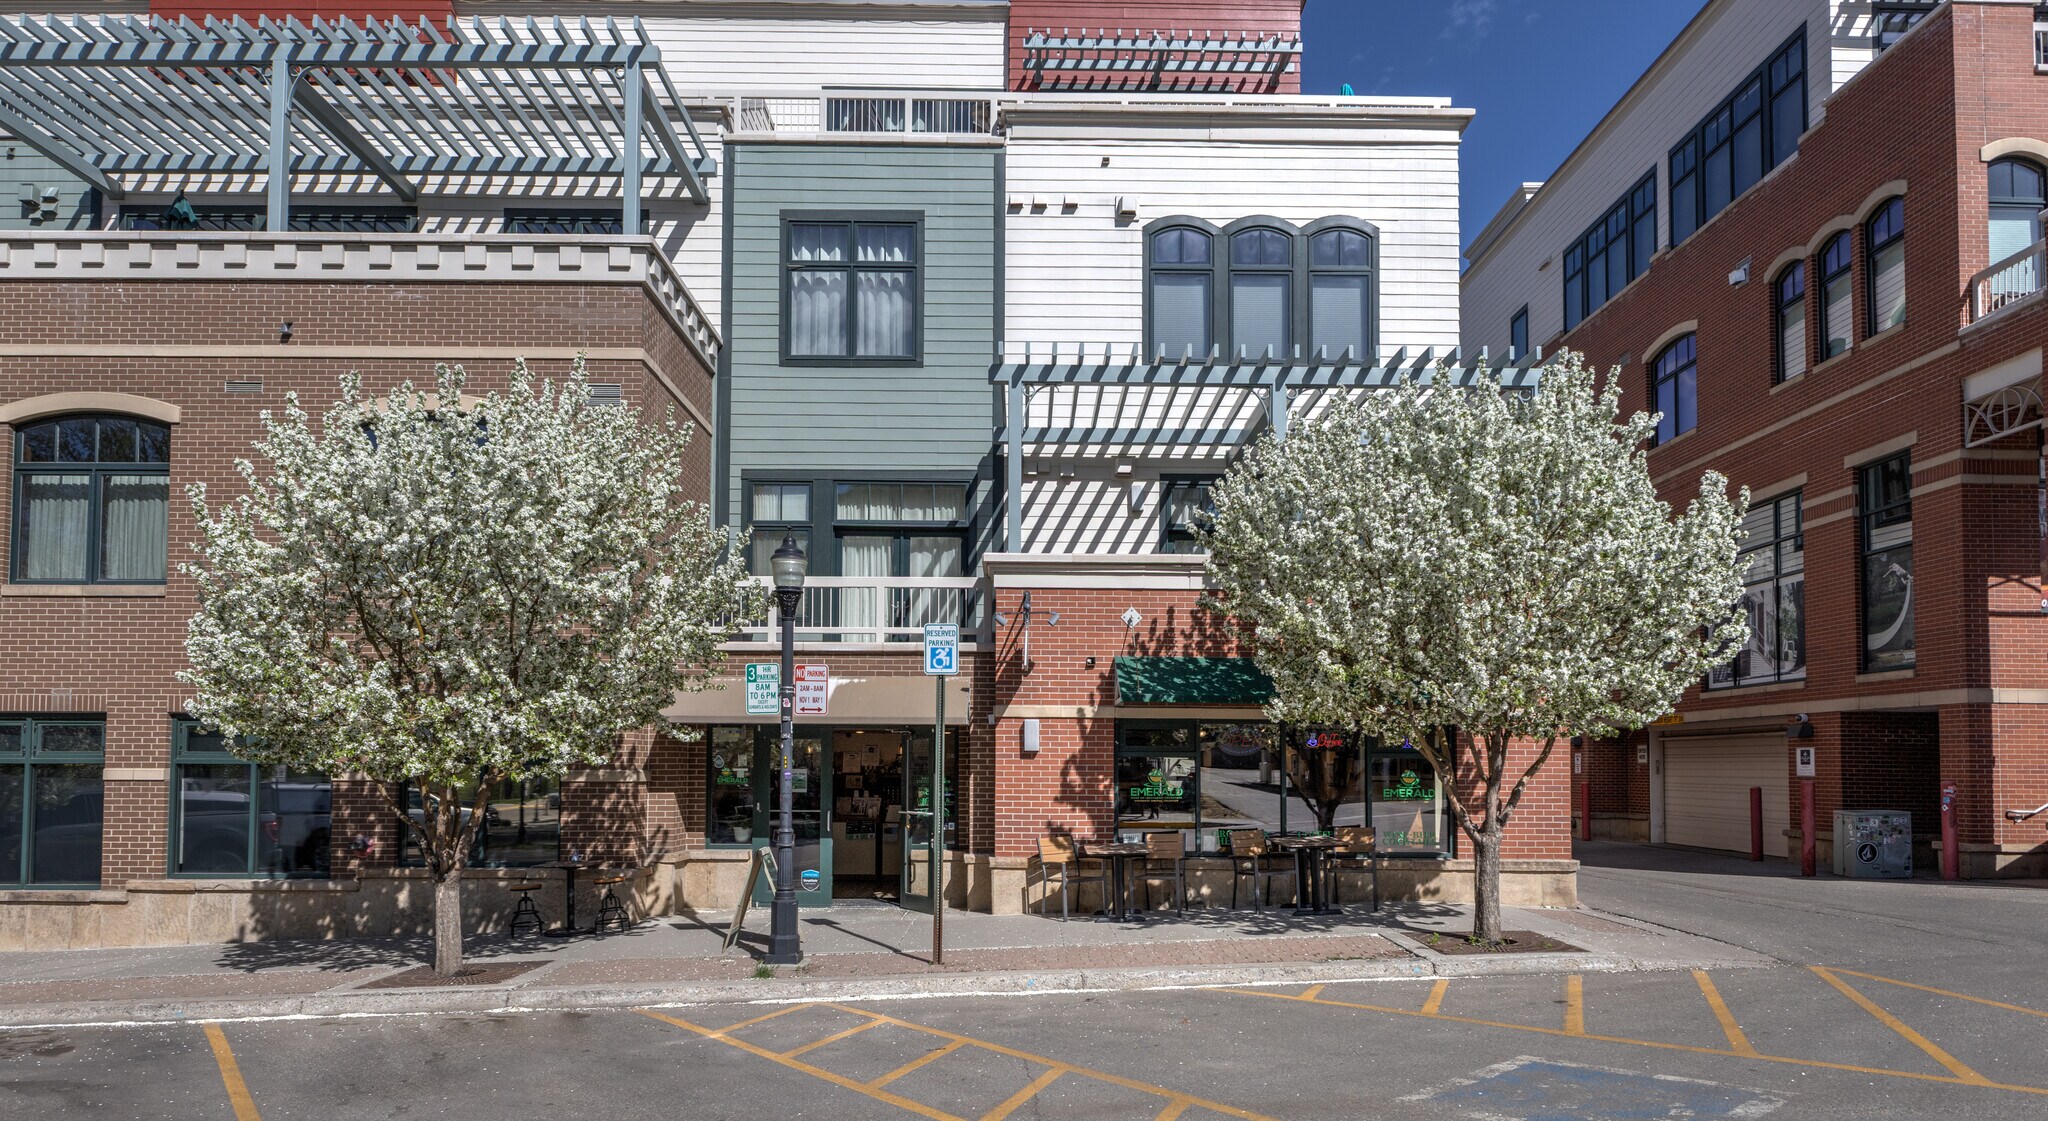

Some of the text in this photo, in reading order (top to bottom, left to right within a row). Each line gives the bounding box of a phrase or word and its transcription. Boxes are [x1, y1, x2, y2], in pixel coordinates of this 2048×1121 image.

[748, 667, 755, 681] 3
[757, 673, 778, 681] PARKING
[796, 668, 825, 678] NO PARKING
[755, 683, 771, 691] 8AM
[750, 692, 777, 700] TO 6 PM
[1130, 787, 1184, 796] EMERALD
[1383, 788, 1436, 798] EMERALD
